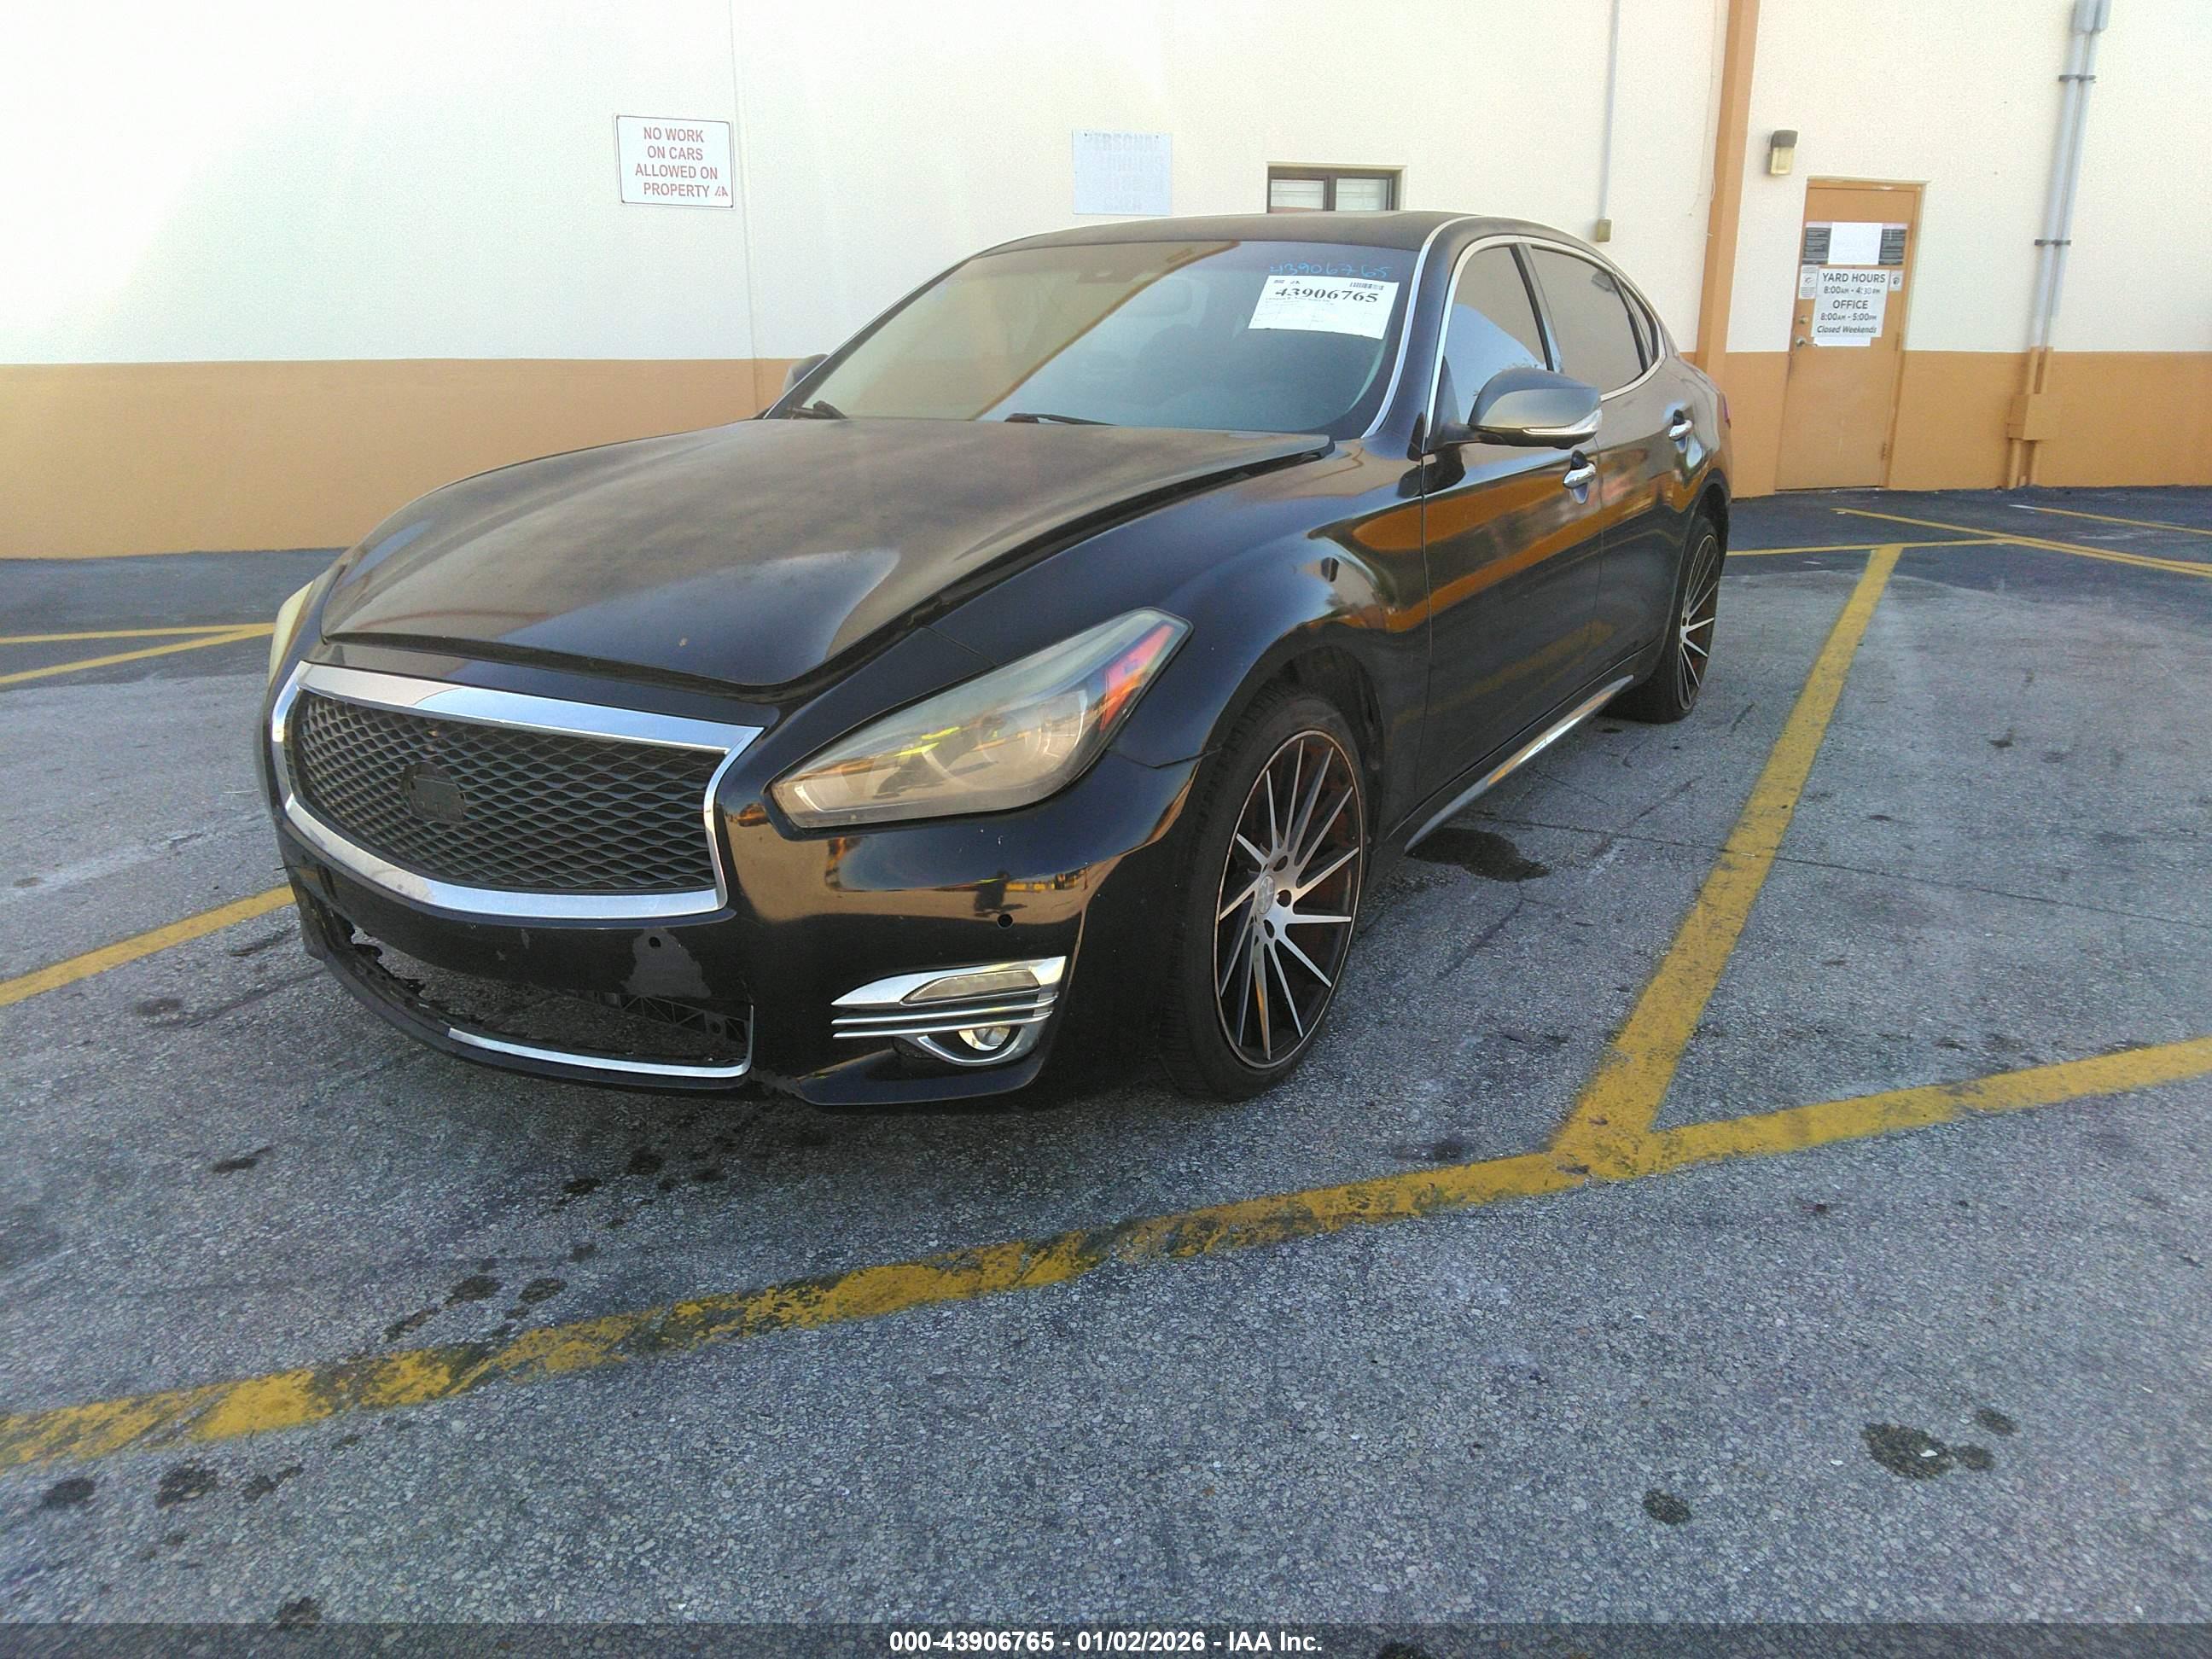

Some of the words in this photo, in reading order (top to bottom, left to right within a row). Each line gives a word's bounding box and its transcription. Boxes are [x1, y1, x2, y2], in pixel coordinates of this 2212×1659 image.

[643, 126, 662, 140] NO
[665, 128, 705, 143] WORK
[647, 145, 666, 159] ON
[669, 147, 703, 160] CARS
[635, 163, 696, 178] ALLOWED
[700, 166, 718, 180] ON
[643, 182, 710, 198] PROPERTY
[1822, 272, 1849, 282] YARD
[1851, 273, 1886, 283] HOURS
[1274, 288, 1379, 303] 43906765
[1832, 300, 1869, 310] OFFICE
[1817, 325, 1841, 334] Closed
[1842, 325, 1877, 334] Weekends
